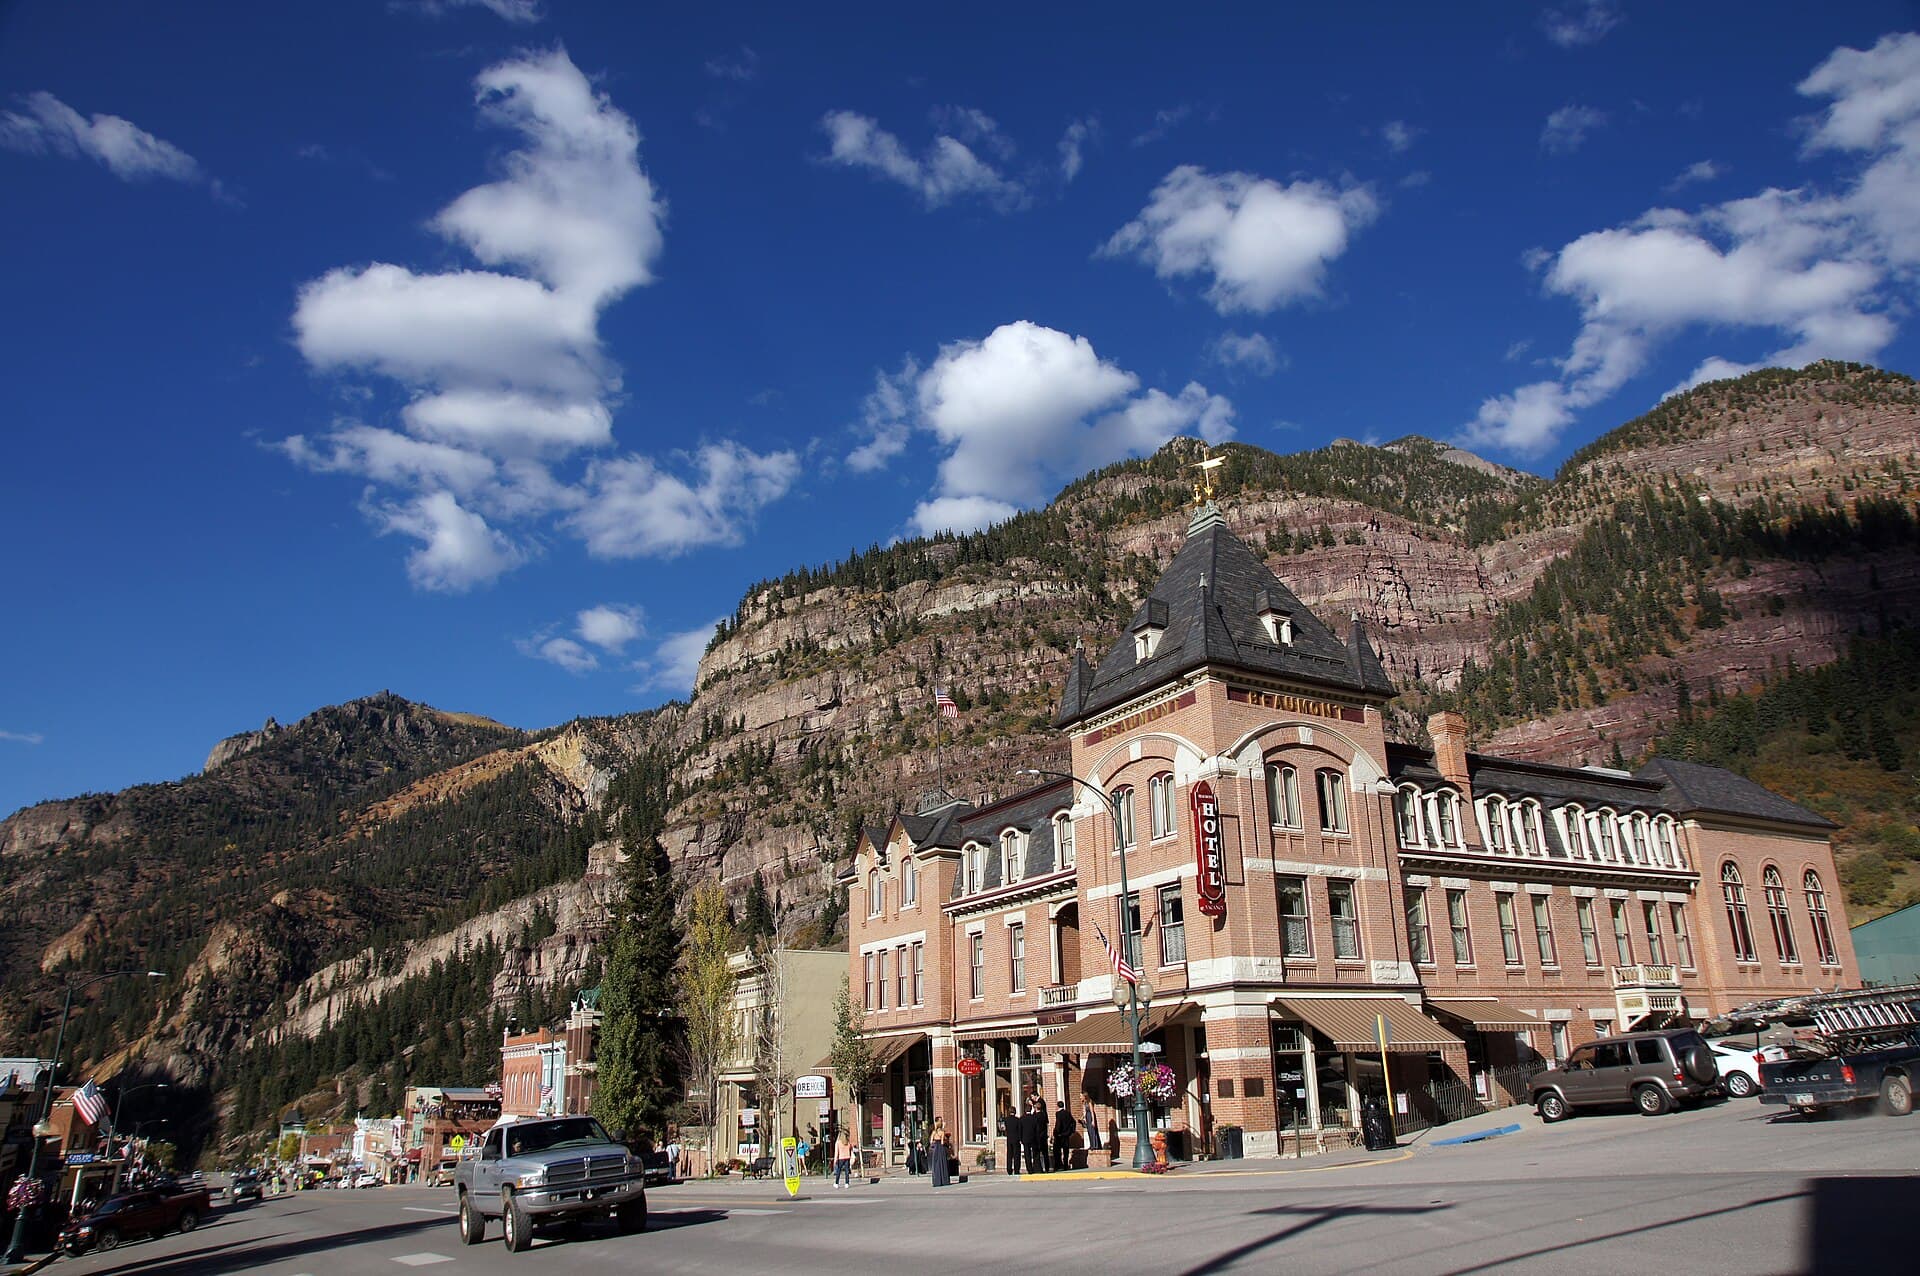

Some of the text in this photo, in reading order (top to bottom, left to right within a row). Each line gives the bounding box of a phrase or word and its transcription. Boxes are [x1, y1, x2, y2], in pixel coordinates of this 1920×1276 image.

[1102, 698, 1181, 740] BEAUMONT
[1248, 689, 1344, 720] BEAUMONT
[1202, 803, 1219, 886] HOTEL
[1774, 1074, 1831, 1083] DODGE
